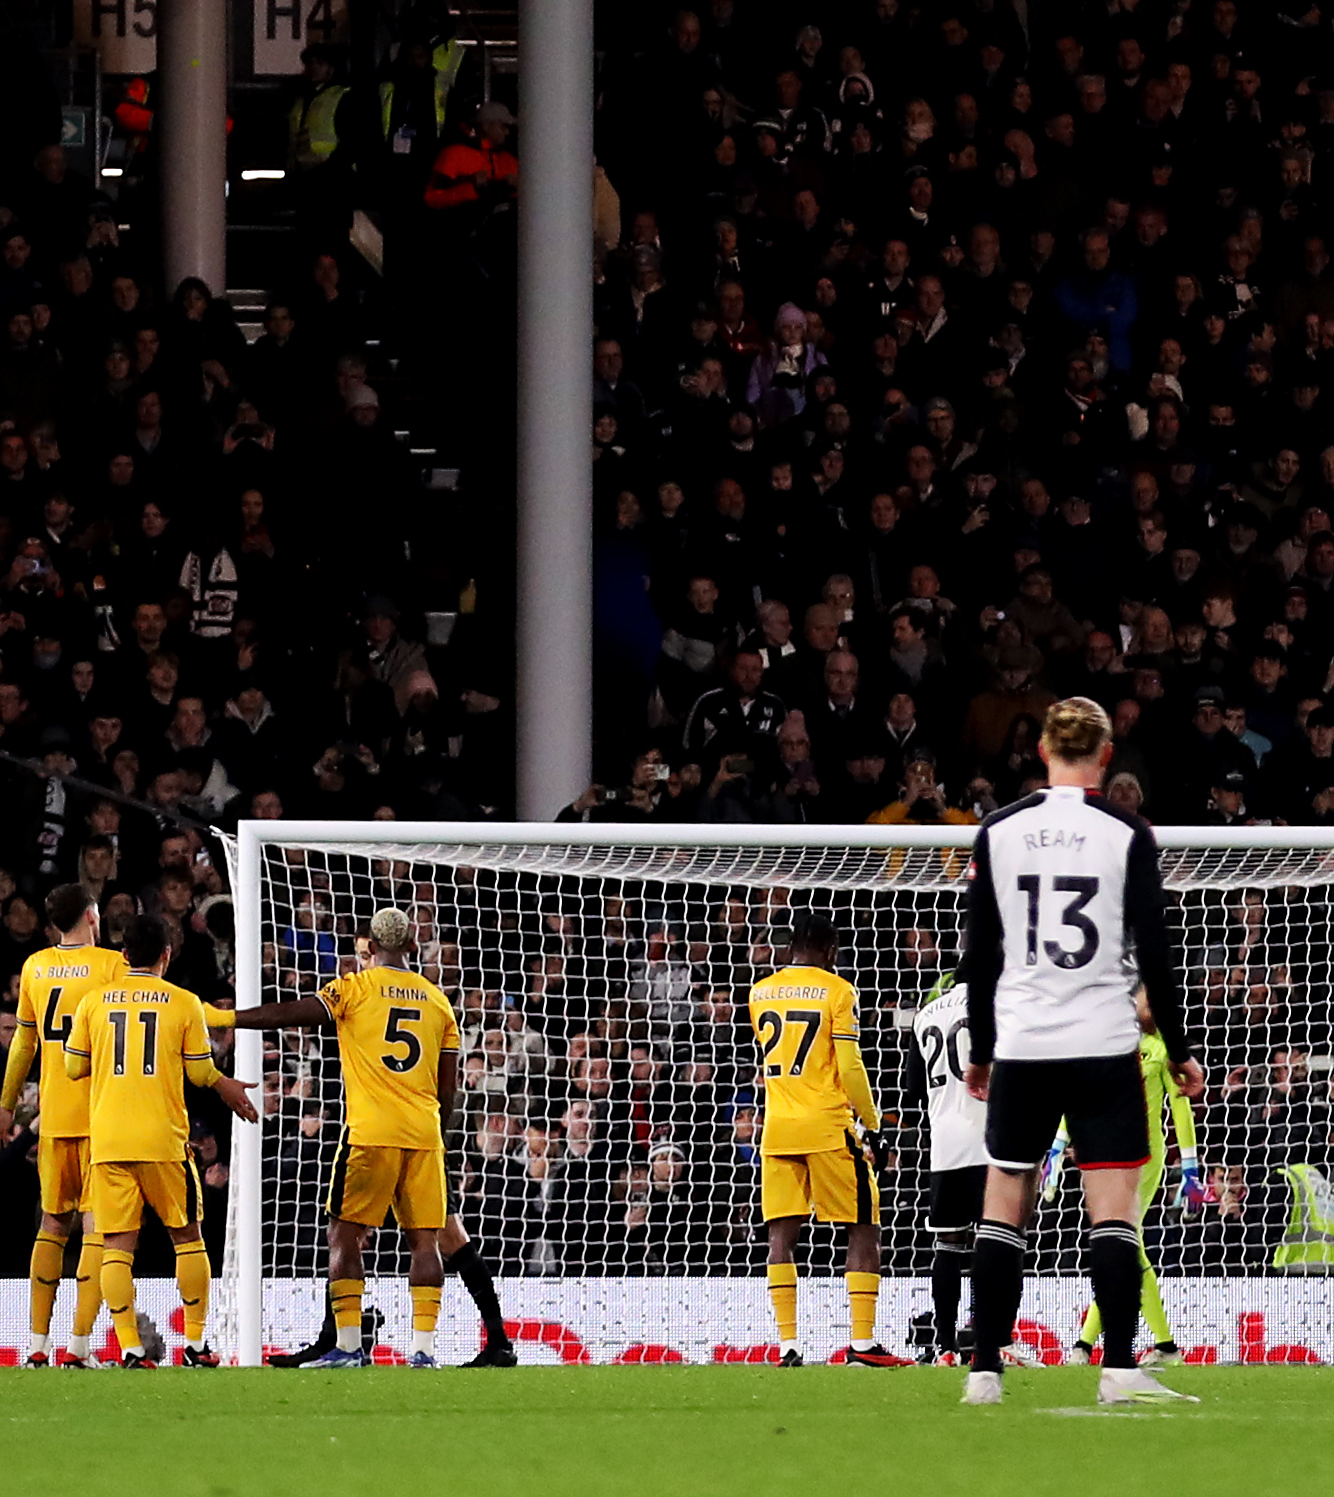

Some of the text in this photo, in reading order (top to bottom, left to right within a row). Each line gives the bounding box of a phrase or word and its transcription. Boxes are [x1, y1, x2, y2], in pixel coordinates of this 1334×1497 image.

[1023, 828, 1087, 852] REAM
[1017, 874, 1100, 970] 13
[47, 965, 89, 978] BUENO
[103, 990, 171, 1004] HEE CHAN
[380, 985, 428, 1001] LEMINA
[752, 985, 828, 1002] BELLEGARDE
[43, 986, 73, 1052] 4
[109, 1011, 158, 1076] 11
[381, 1006, 422, 1073] 5
[757, 1010, 822, 1077] 27
[921, 1016, 970, 1090] 20
